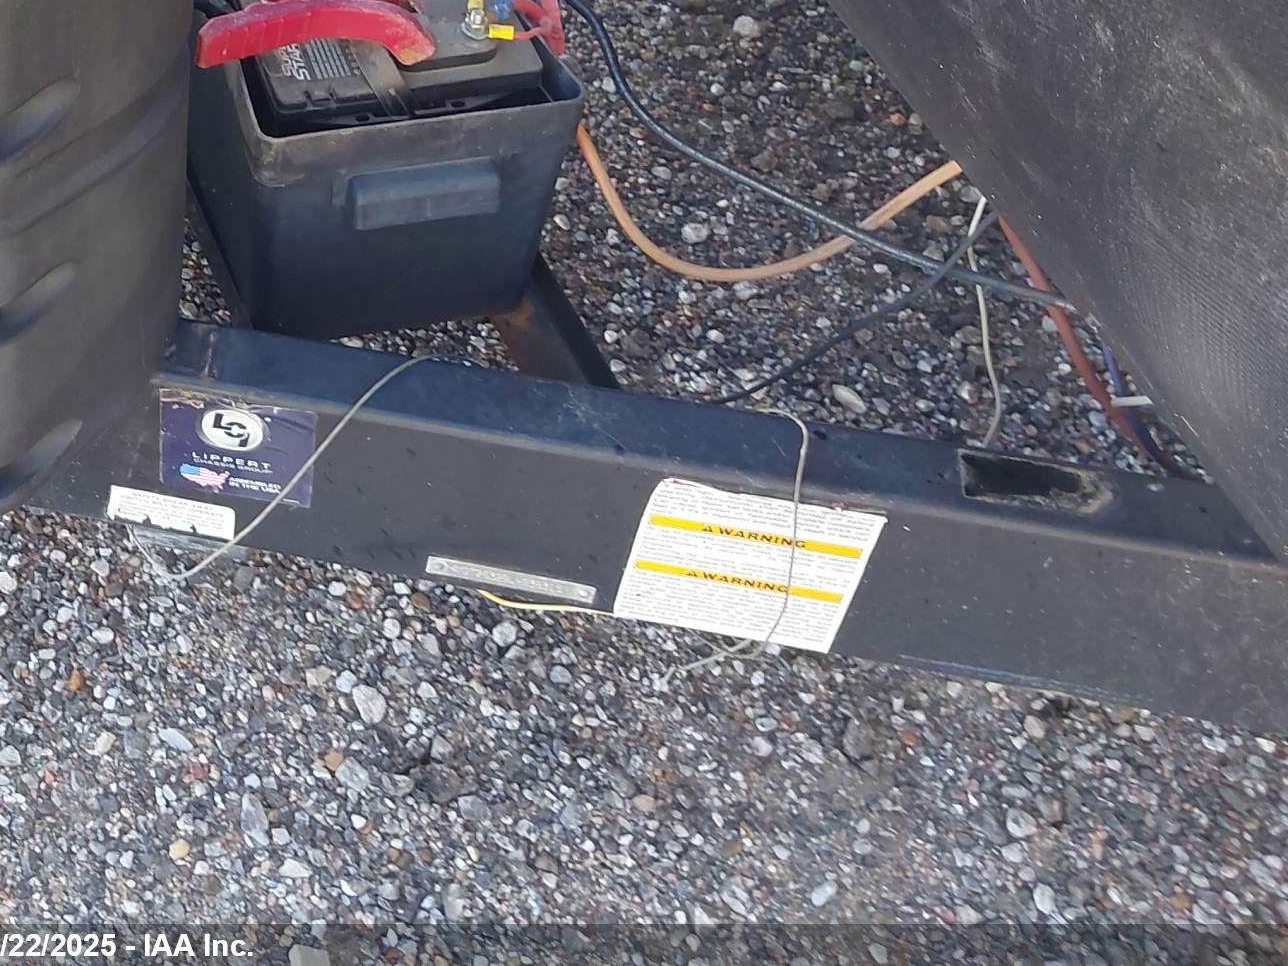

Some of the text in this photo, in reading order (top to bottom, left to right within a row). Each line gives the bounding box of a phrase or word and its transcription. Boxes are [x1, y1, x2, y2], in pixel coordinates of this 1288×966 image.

[287, 42, 311, 81] STAR
[192, 451, 271, 470] LIPPERT
[719, 525, 808, 549] WARNING
[702, 570, 790, 594] WARNING
